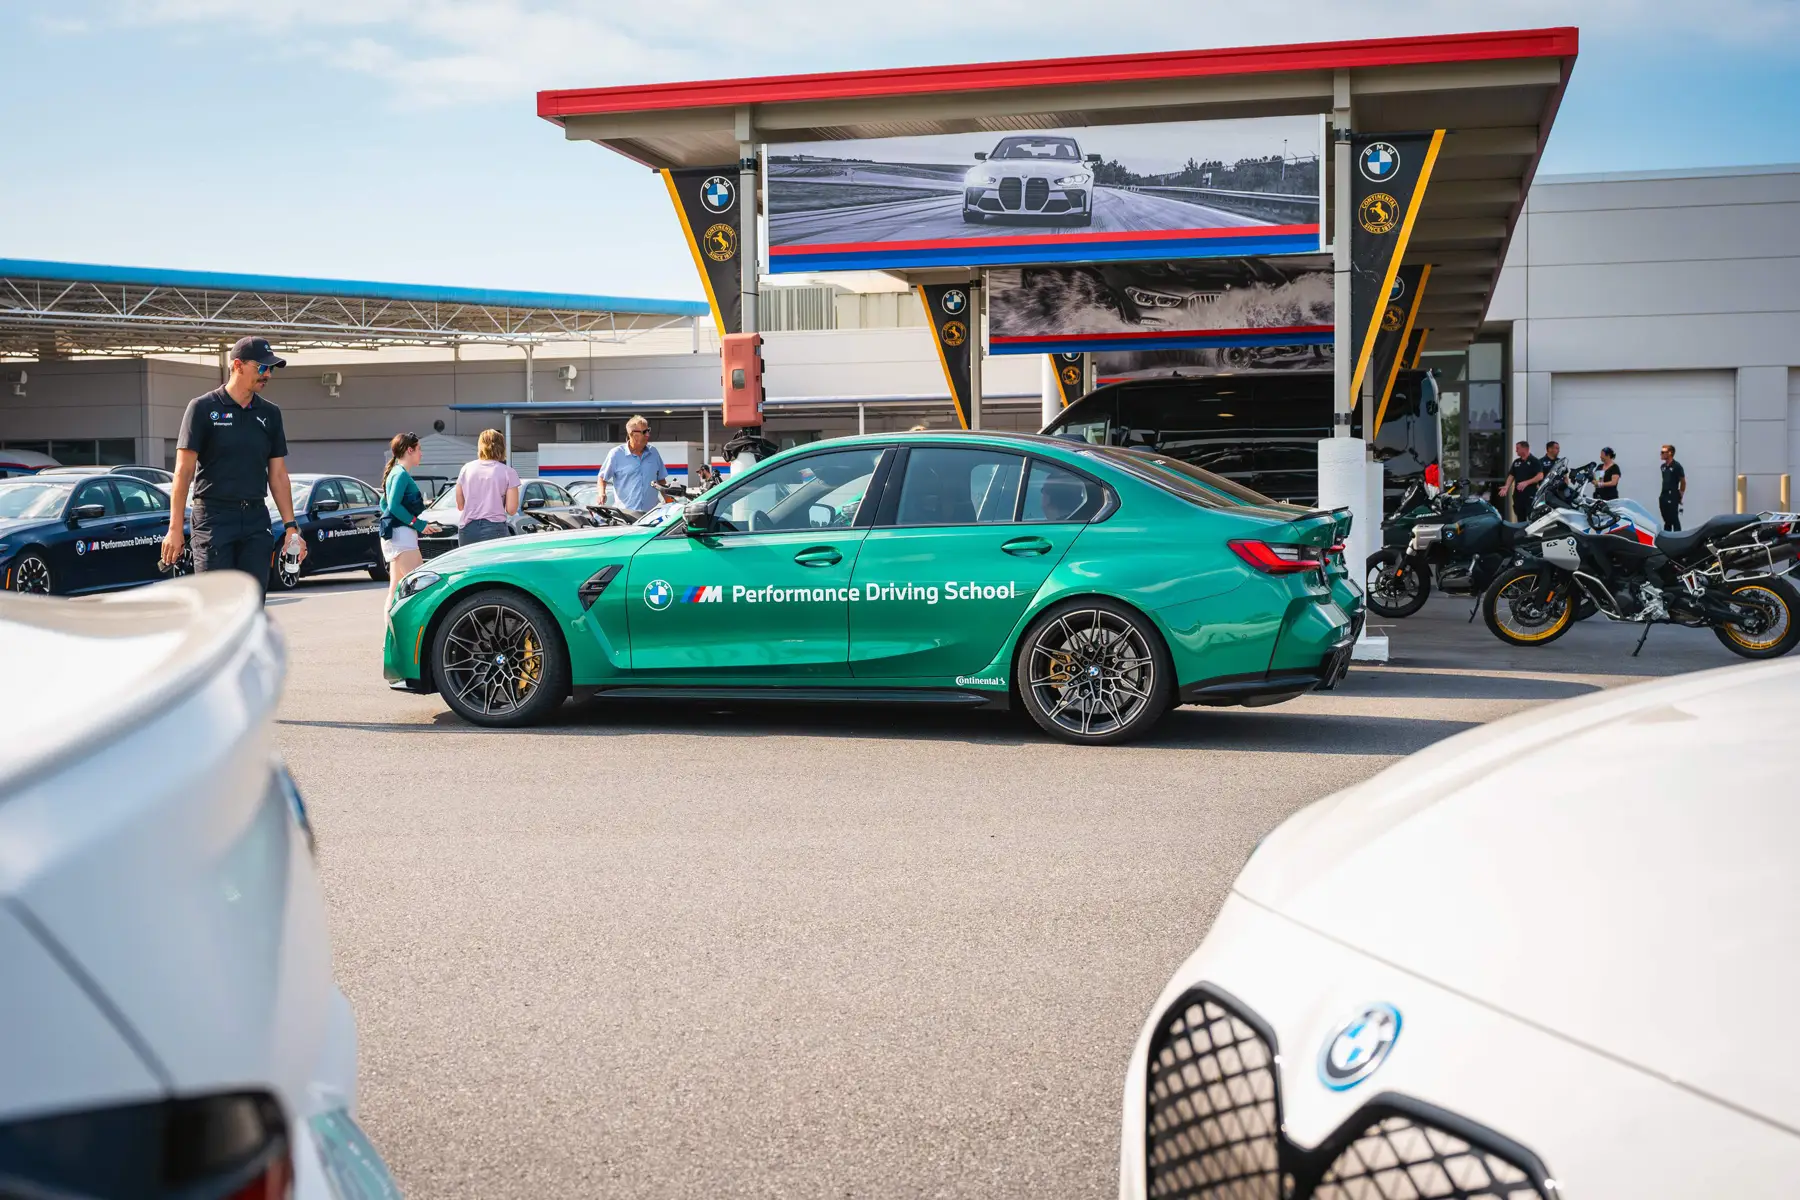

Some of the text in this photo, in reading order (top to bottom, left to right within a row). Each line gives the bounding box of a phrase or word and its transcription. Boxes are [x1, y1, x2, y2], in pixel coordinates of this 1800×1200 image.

[1365, 144, 1395, 156] BMW
[704, 178, 730, 190] BMW
[1361, 193, 1397, 209] CONTINENTAL
[705, 225, 735, 239] CONTINENTAL
[1364, 222, 1381, 233] SINCE
[100, 539, 135, 550] Performance
[134, 535, 153, 546] Driving
[732, 584, 860, 603] Performance
[866, 582, 939, 605] Driving
[944, 581, 1015, 600] School
[955, 675, 999, 687] Continental
